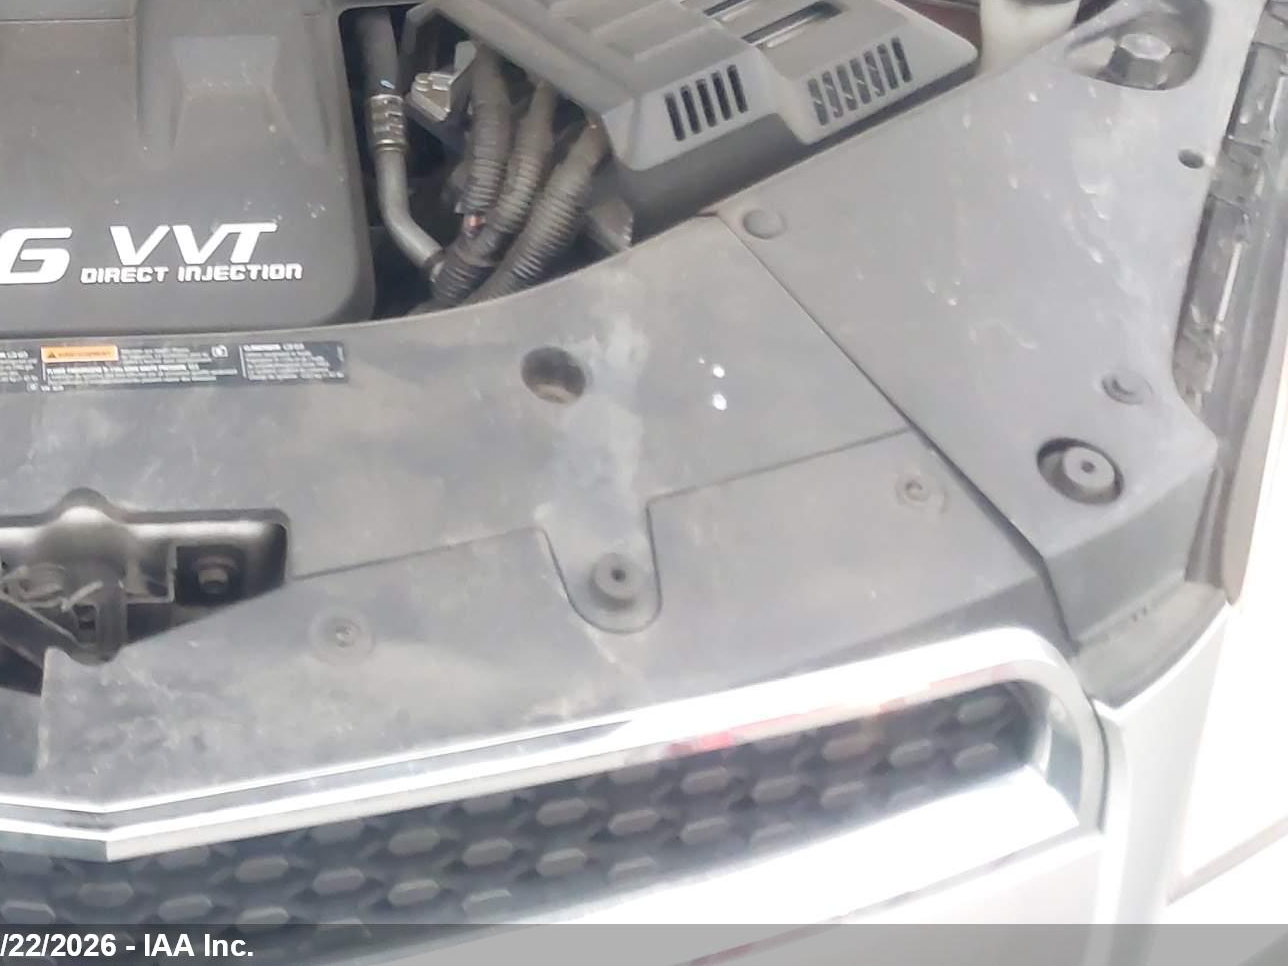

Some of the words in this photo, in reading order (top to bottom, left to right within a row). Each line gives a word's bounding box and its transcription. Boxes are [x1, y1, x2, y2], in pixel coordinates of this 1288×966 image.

[109, 222, 278, 266] VVT
[80, 265, 169, 284] DIRECT
[177, 263, 303, 282] INJECTION
